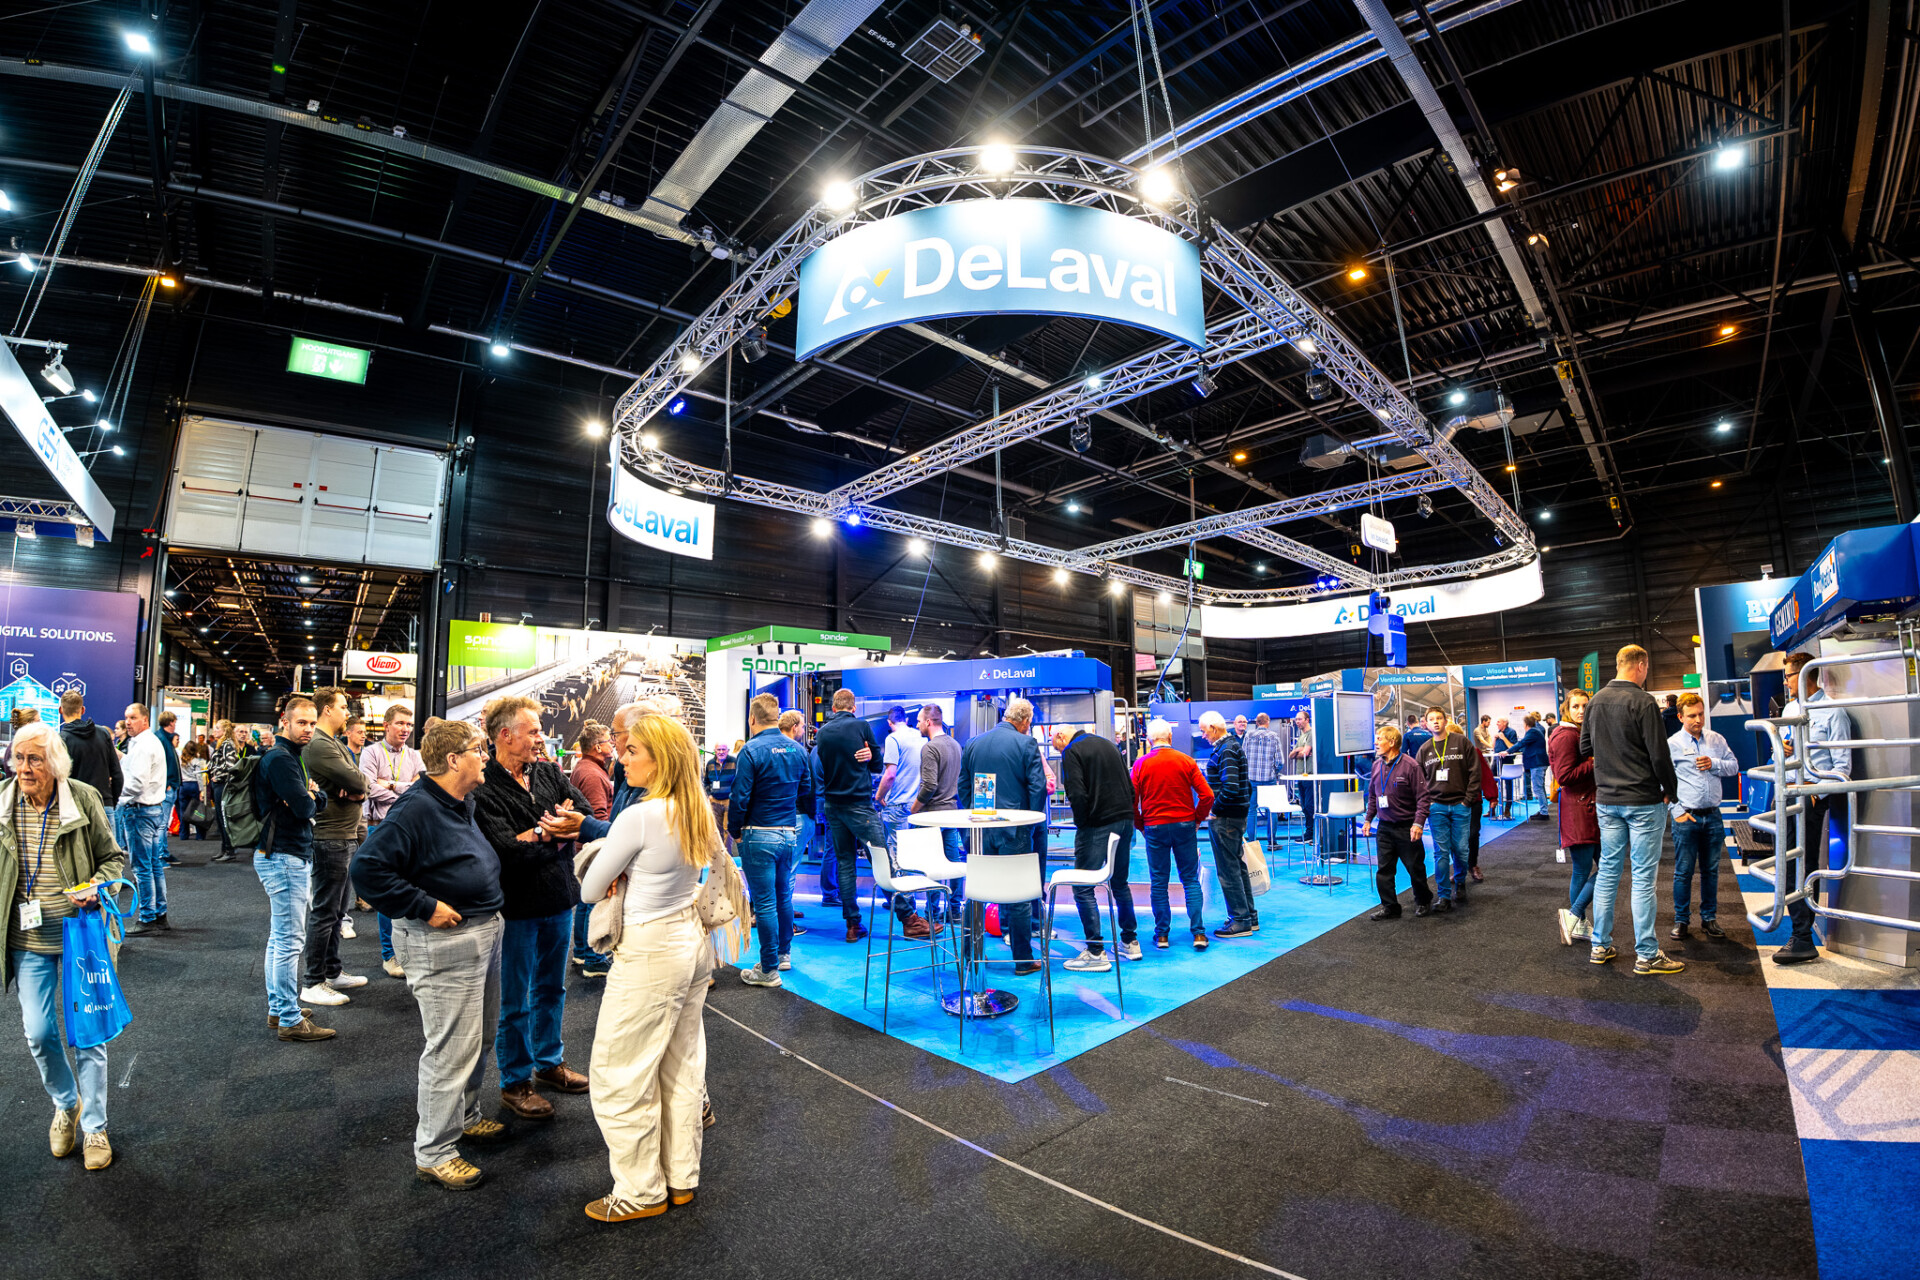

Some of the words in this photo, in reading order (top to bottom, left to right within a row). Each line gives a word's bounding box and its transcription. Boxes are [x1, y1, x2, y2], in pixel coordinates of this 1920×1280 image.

[903, 233, 1177, 316] DeLaval
[1358, 595, 1435, 622] Daval
[1745, 597, 1784, 618] BV
[40, 628, 117, 643] SOLUTIONS.
[819, 633, 849, 642] spinder
[371, 656, 397, 669] Vicon
[1507, 665, 1513, 673] &
[993, 668, 1036, 679] DeLaval
[1584, 662, 1594, 689] BOER
